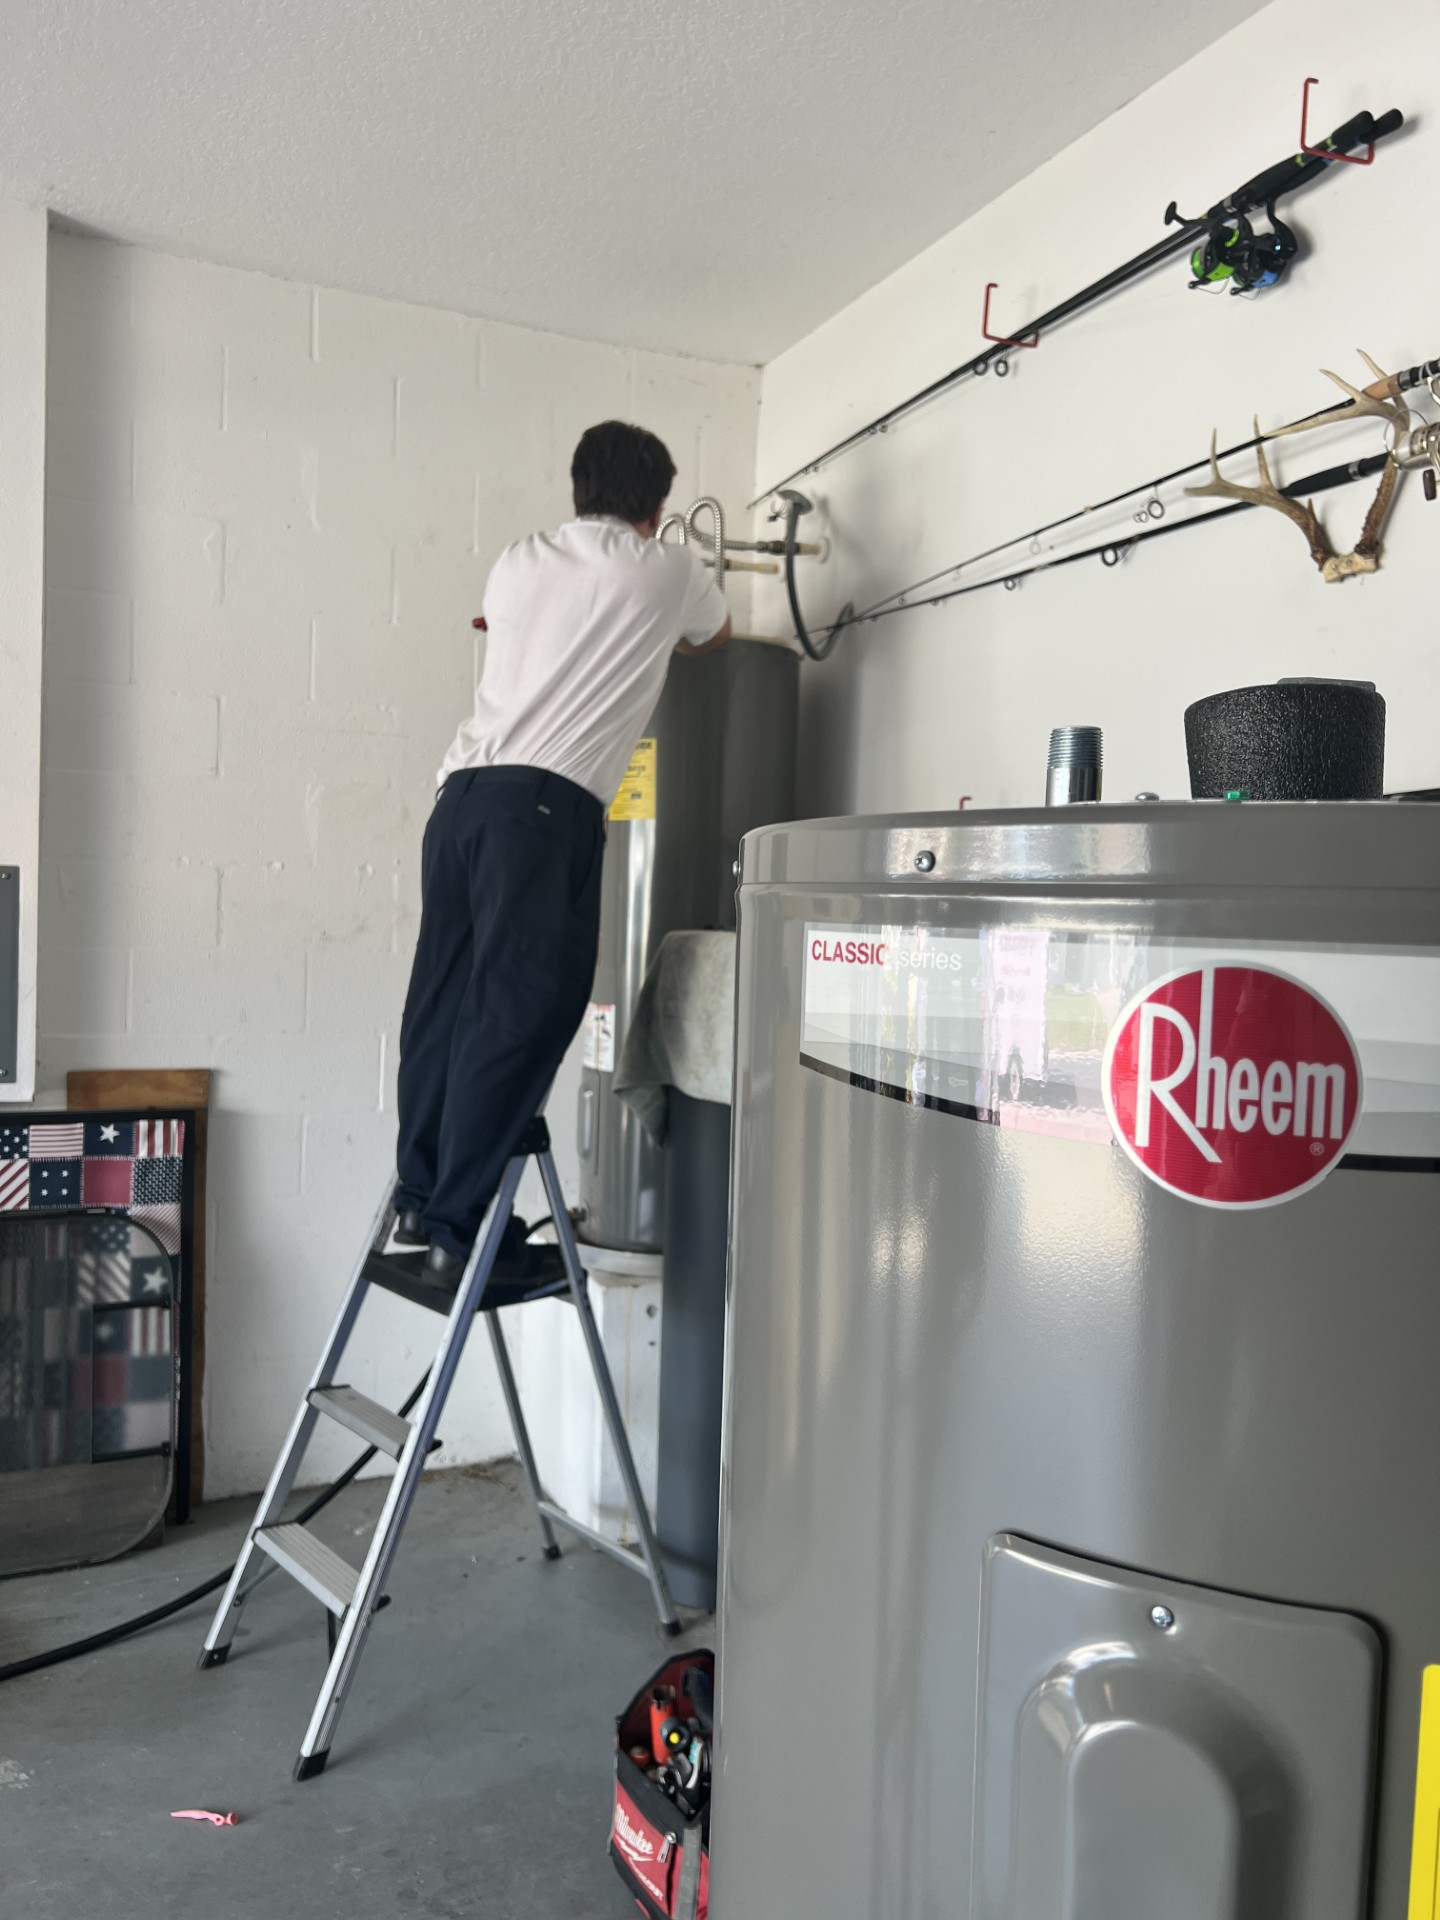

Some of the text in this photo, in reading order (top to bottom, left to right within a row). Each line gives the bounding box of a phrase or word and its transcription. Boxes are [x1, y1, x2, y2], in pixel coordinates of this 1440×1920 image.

[811, 939, 961, 971] CLASSIC series
[1135, 967, 1346, 1163] Rheem
